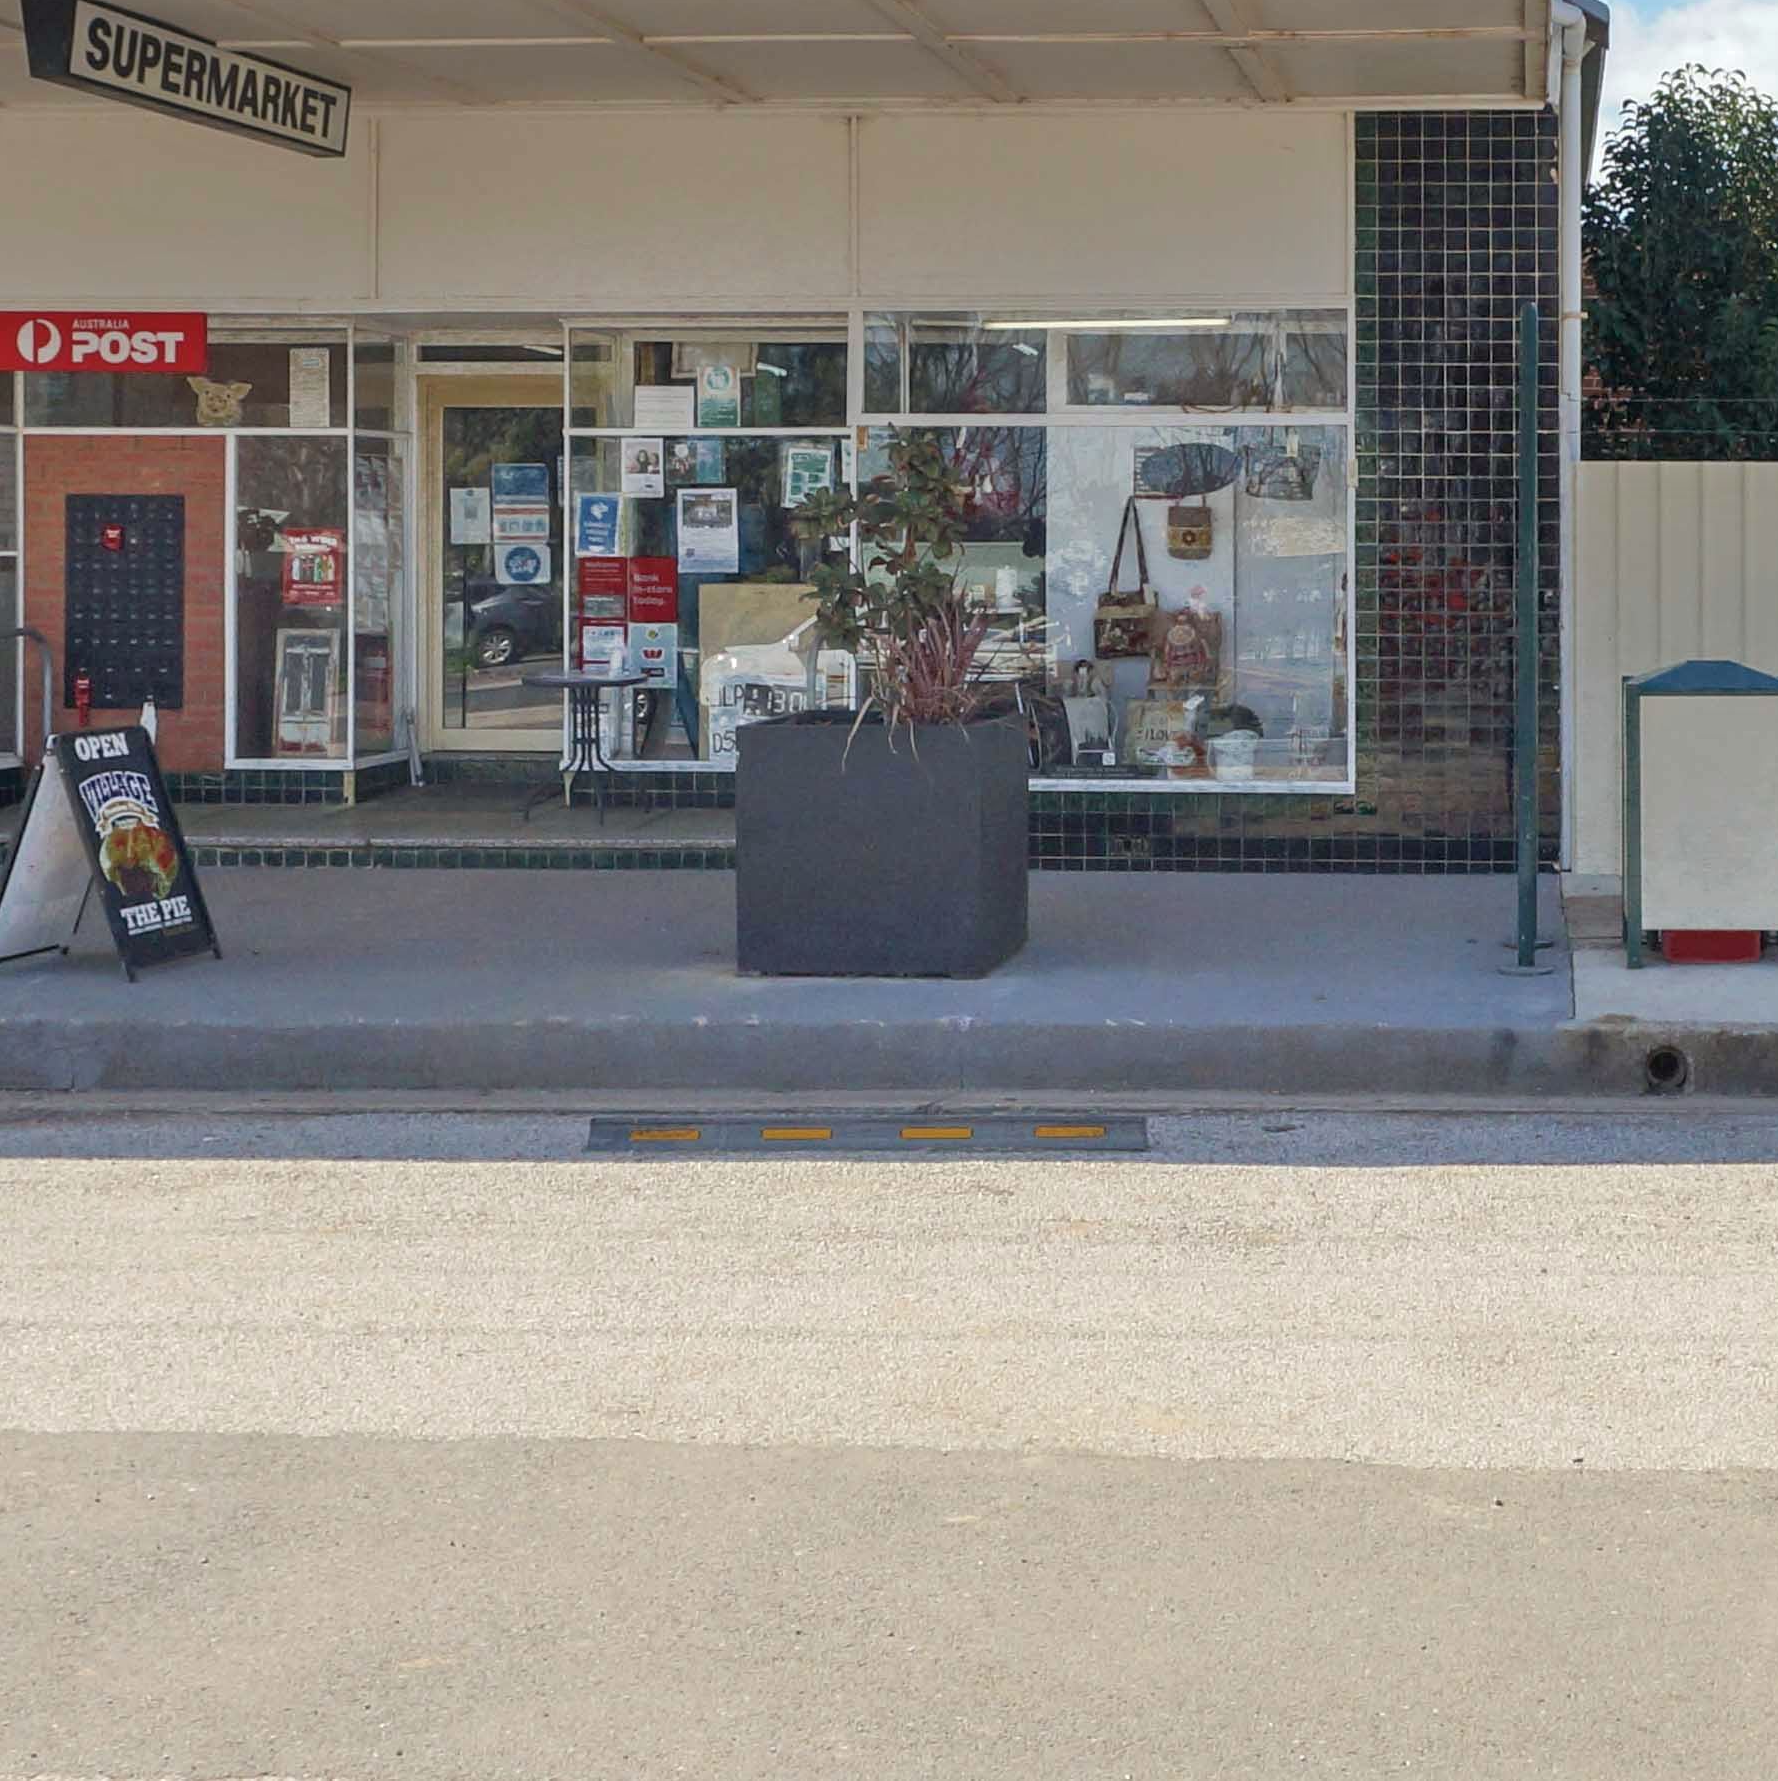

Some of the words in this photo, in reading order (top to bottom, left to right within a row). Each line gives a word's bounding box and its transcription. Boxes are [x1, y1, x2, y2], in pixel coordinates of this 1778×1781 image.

[85, 17, 337, 139] SUPERMARKET
[72, 319, 130, 330] AUSTRALIA
[72, 330, 185, 365] POST
[74, 732, 130, 761] OPEN
[119, 901, 162, 930] THE
[159, 894, 192, 919] PIE
